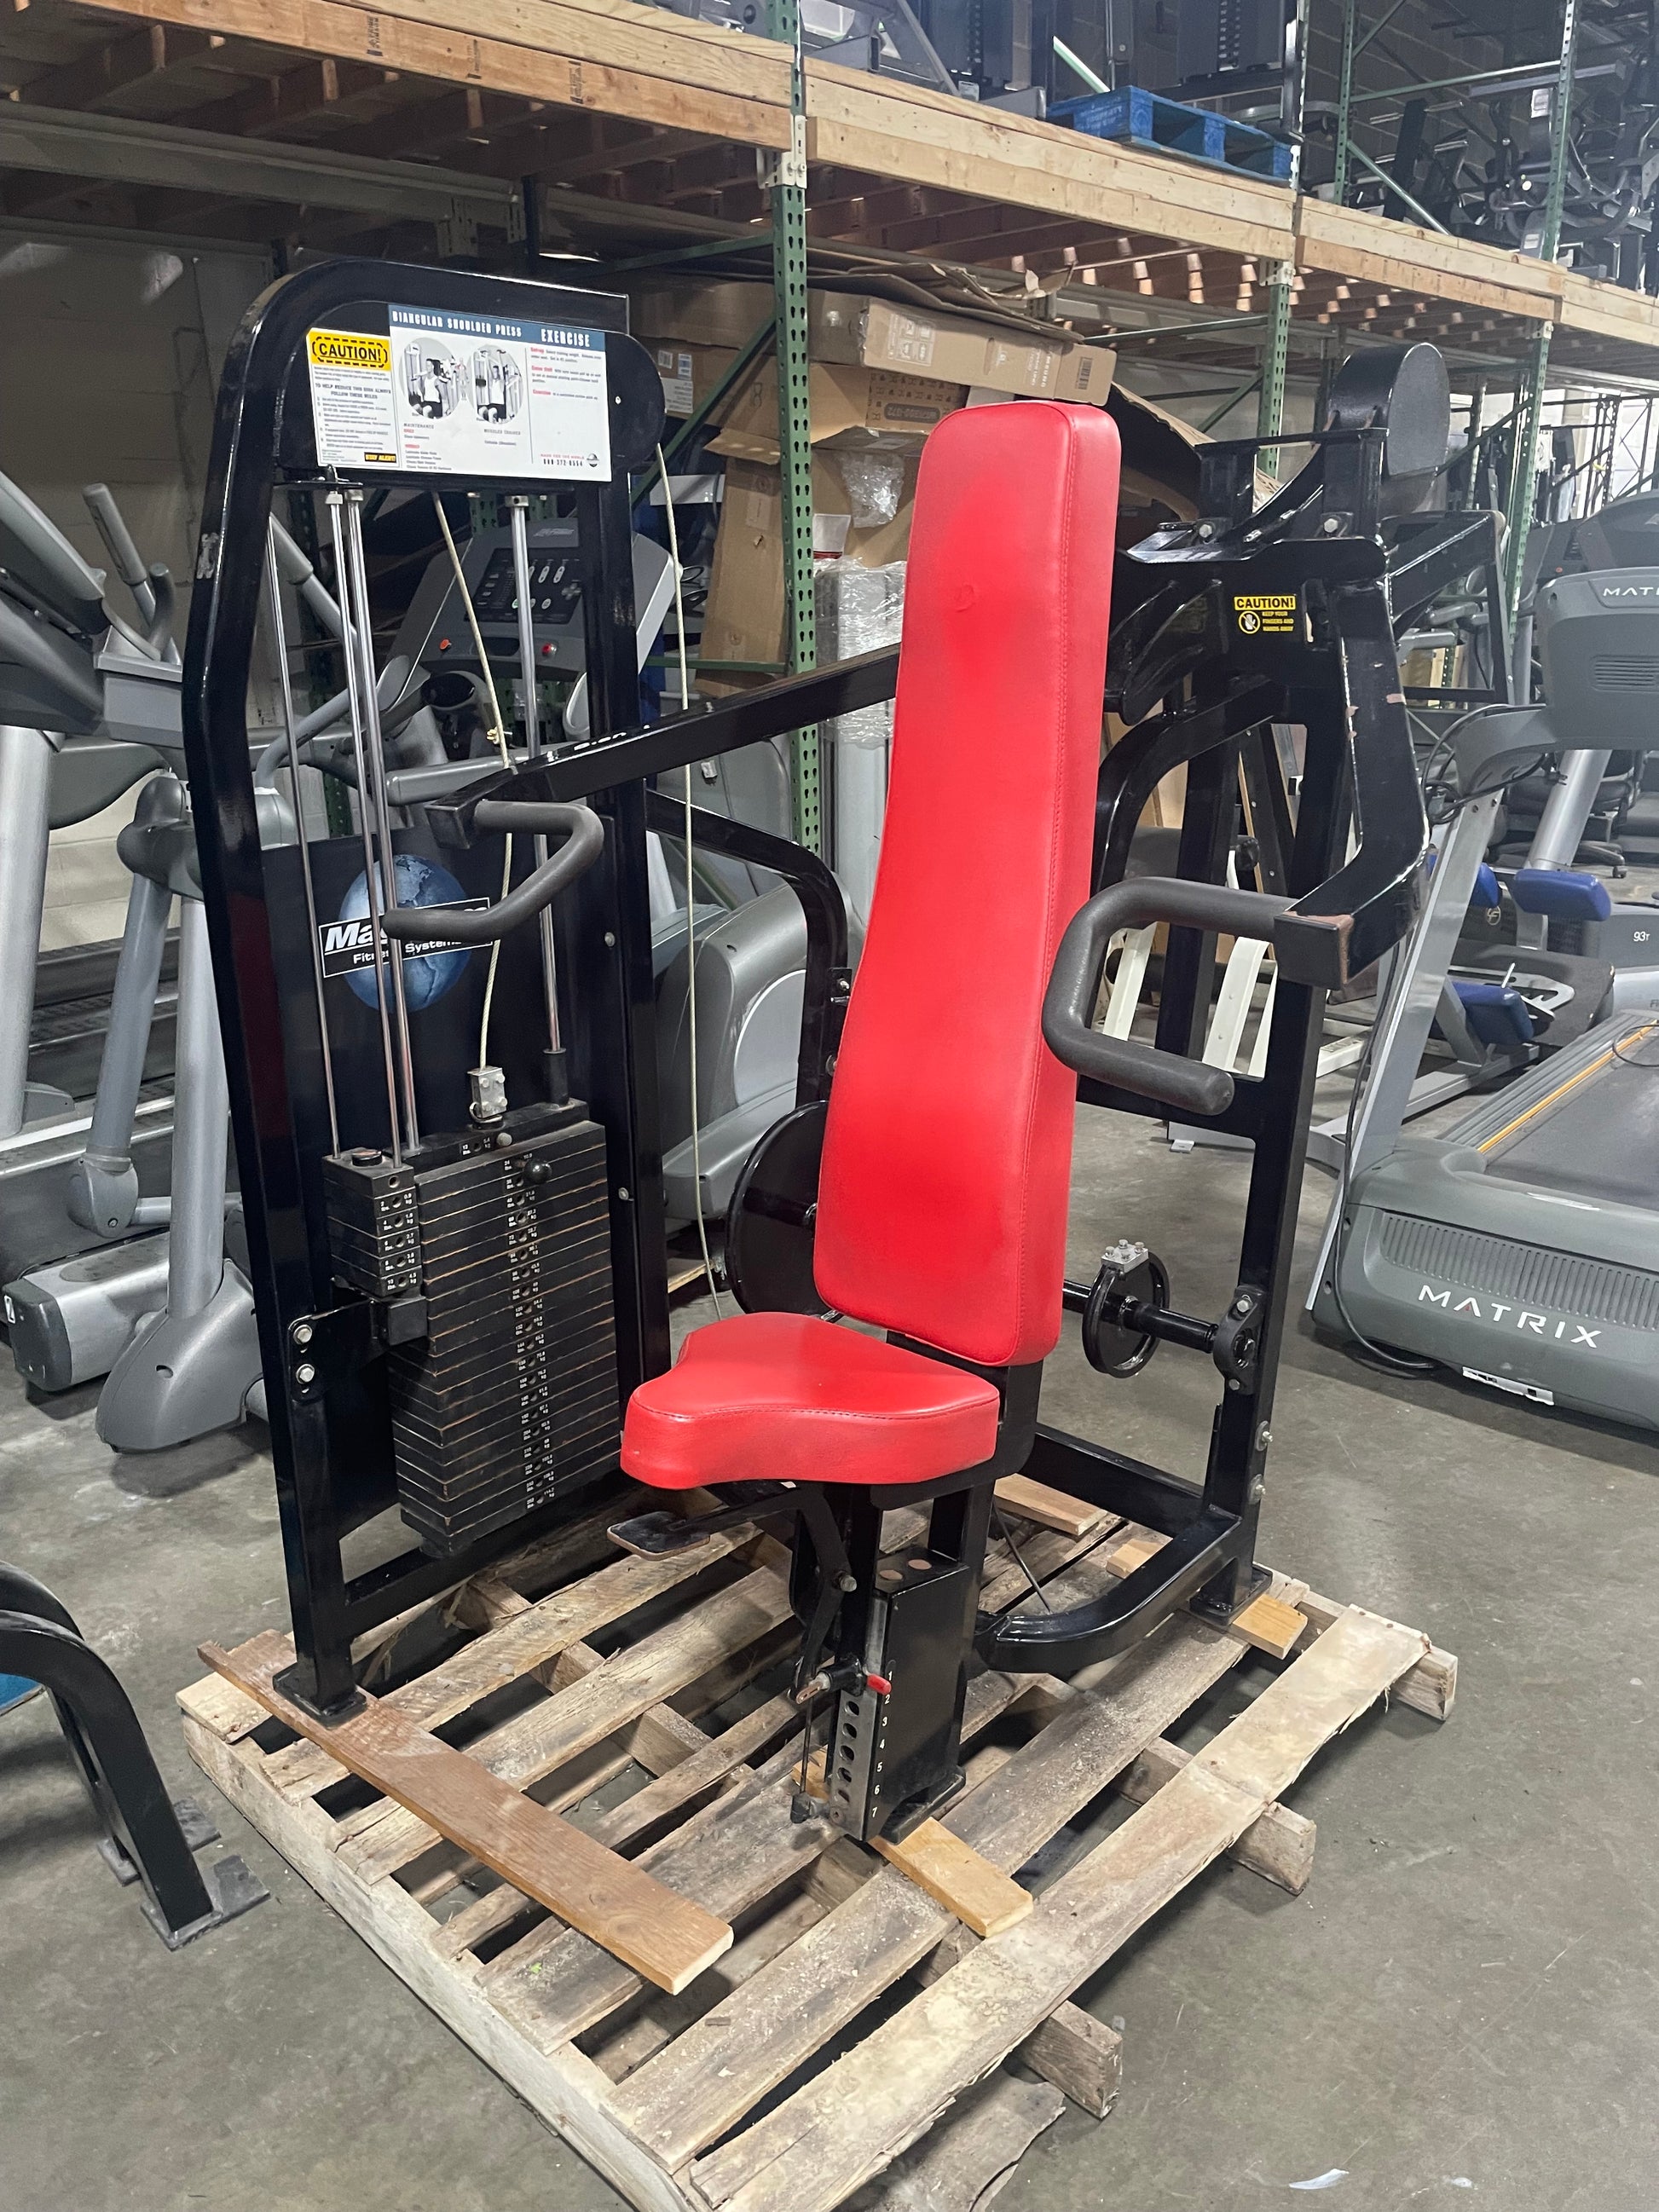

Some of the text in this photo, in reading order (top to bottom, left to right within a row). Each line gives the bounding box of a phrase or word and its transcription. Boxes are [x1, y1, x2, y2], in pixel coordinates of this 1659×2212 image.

[392, 310, 522, 338] BIANGULAR SHOULDER PRESS
[540, 328, 591, 348] EXERCISE
[319, 343, 381, 361] CAUTION!
[1236, 598, 1293, 609] CAUTION!
[1418, 1285, 1602, 1349] MATRIX
[888, 1671, 893, 1681] 1
[884, 1694, 890, 1704] 2
[882, 1716, 888, 1727] 3
[879, 1739, 886, 1749] 4
[876, 1761, 883, 1772] 5
[874, 1784, 881, 1795] 6
[872, 1806, 877, 1817] 7
